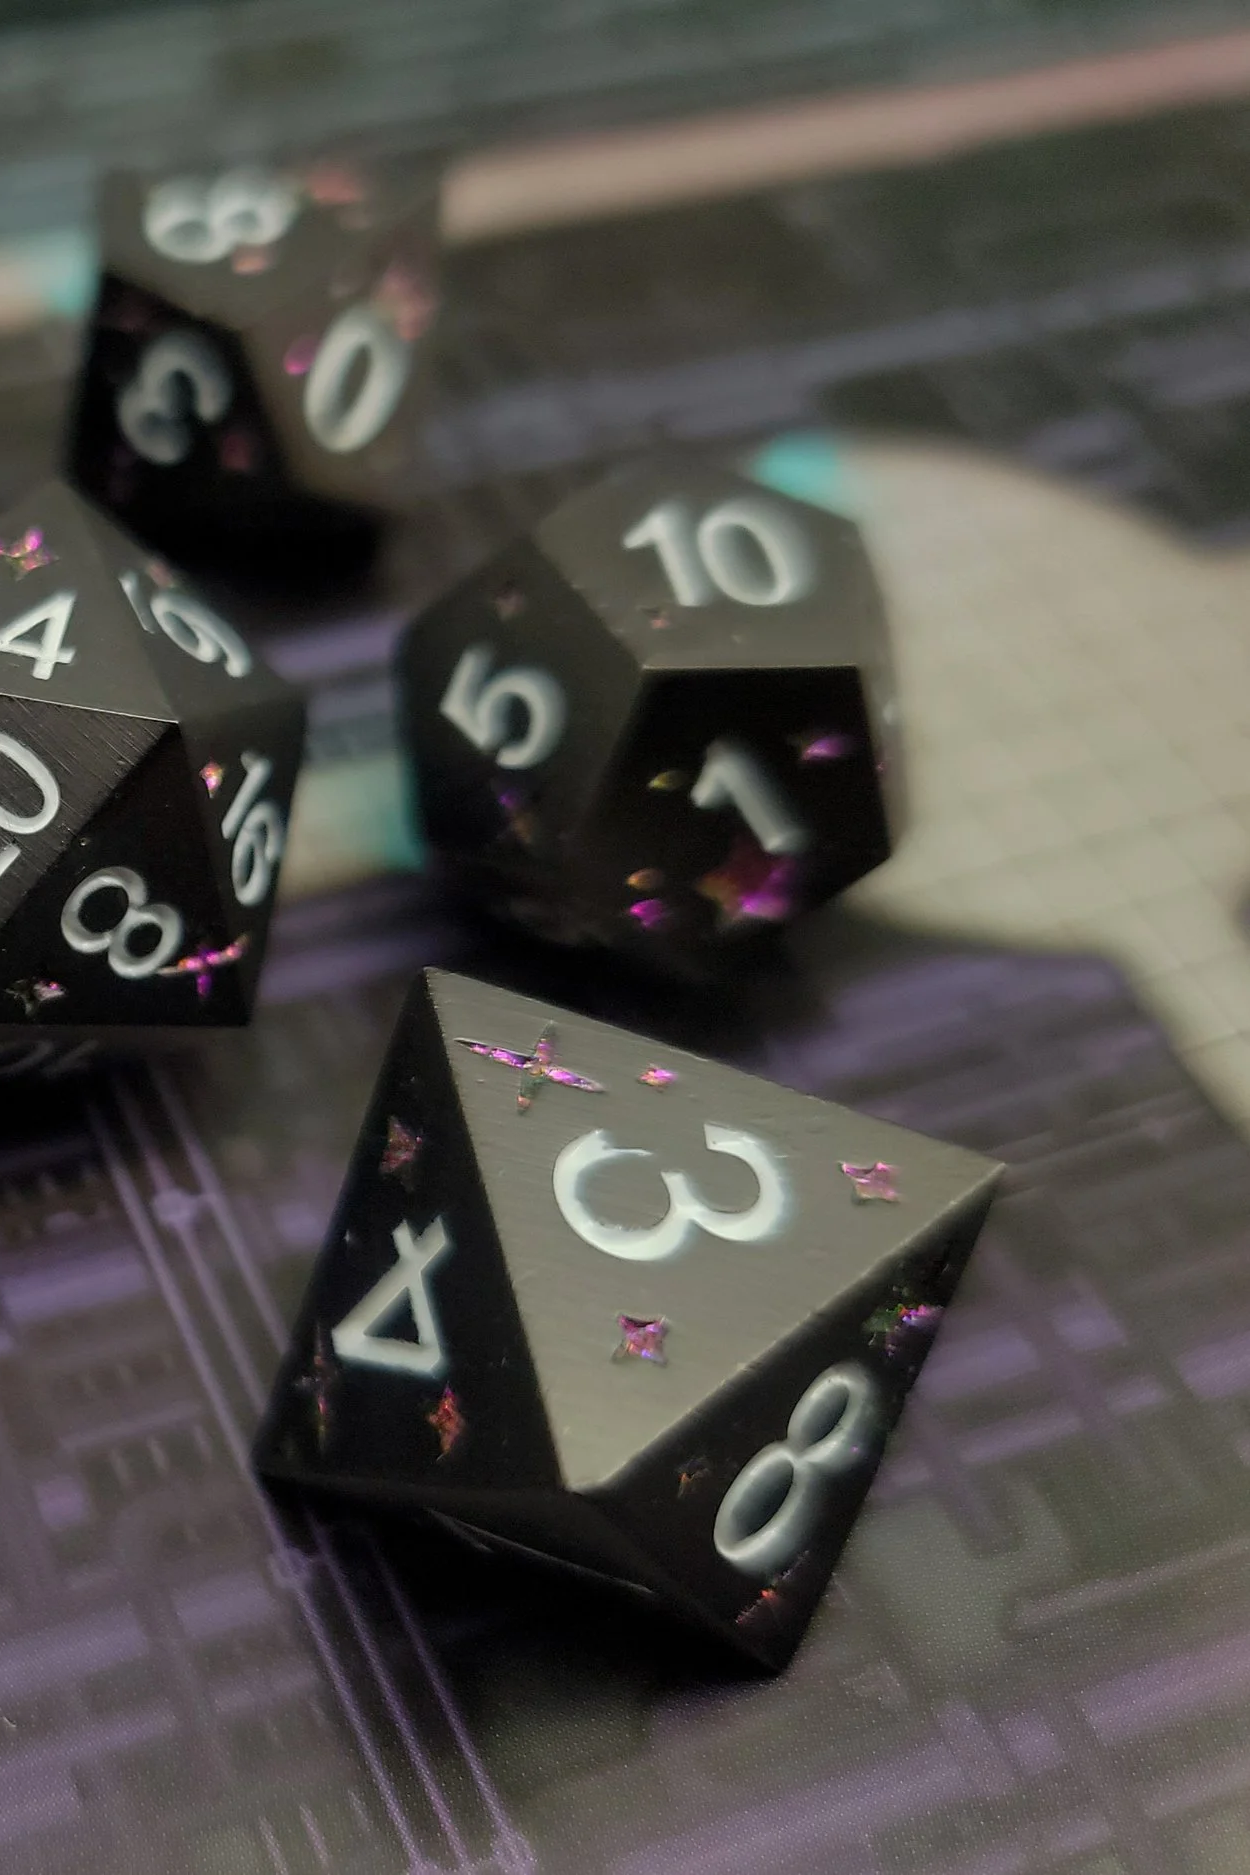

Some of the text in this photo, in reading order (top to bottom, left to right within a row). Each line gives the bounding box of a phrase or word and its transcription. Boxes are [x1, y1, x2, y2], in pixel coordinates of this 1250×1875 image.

[302, 305, 414, 453] 0
[621, 499, 816, 607] 10
[440, 643, 568, 769] 5
[221, 749, 285, 906] 16
[690, 735, 808, 855] 1
[61, 866, 185, 980] 8
[552, 1122, 790, 1262] 3
[332, 1215, 450, 1376] 4
[714, 1364, 868, 1572] 8
